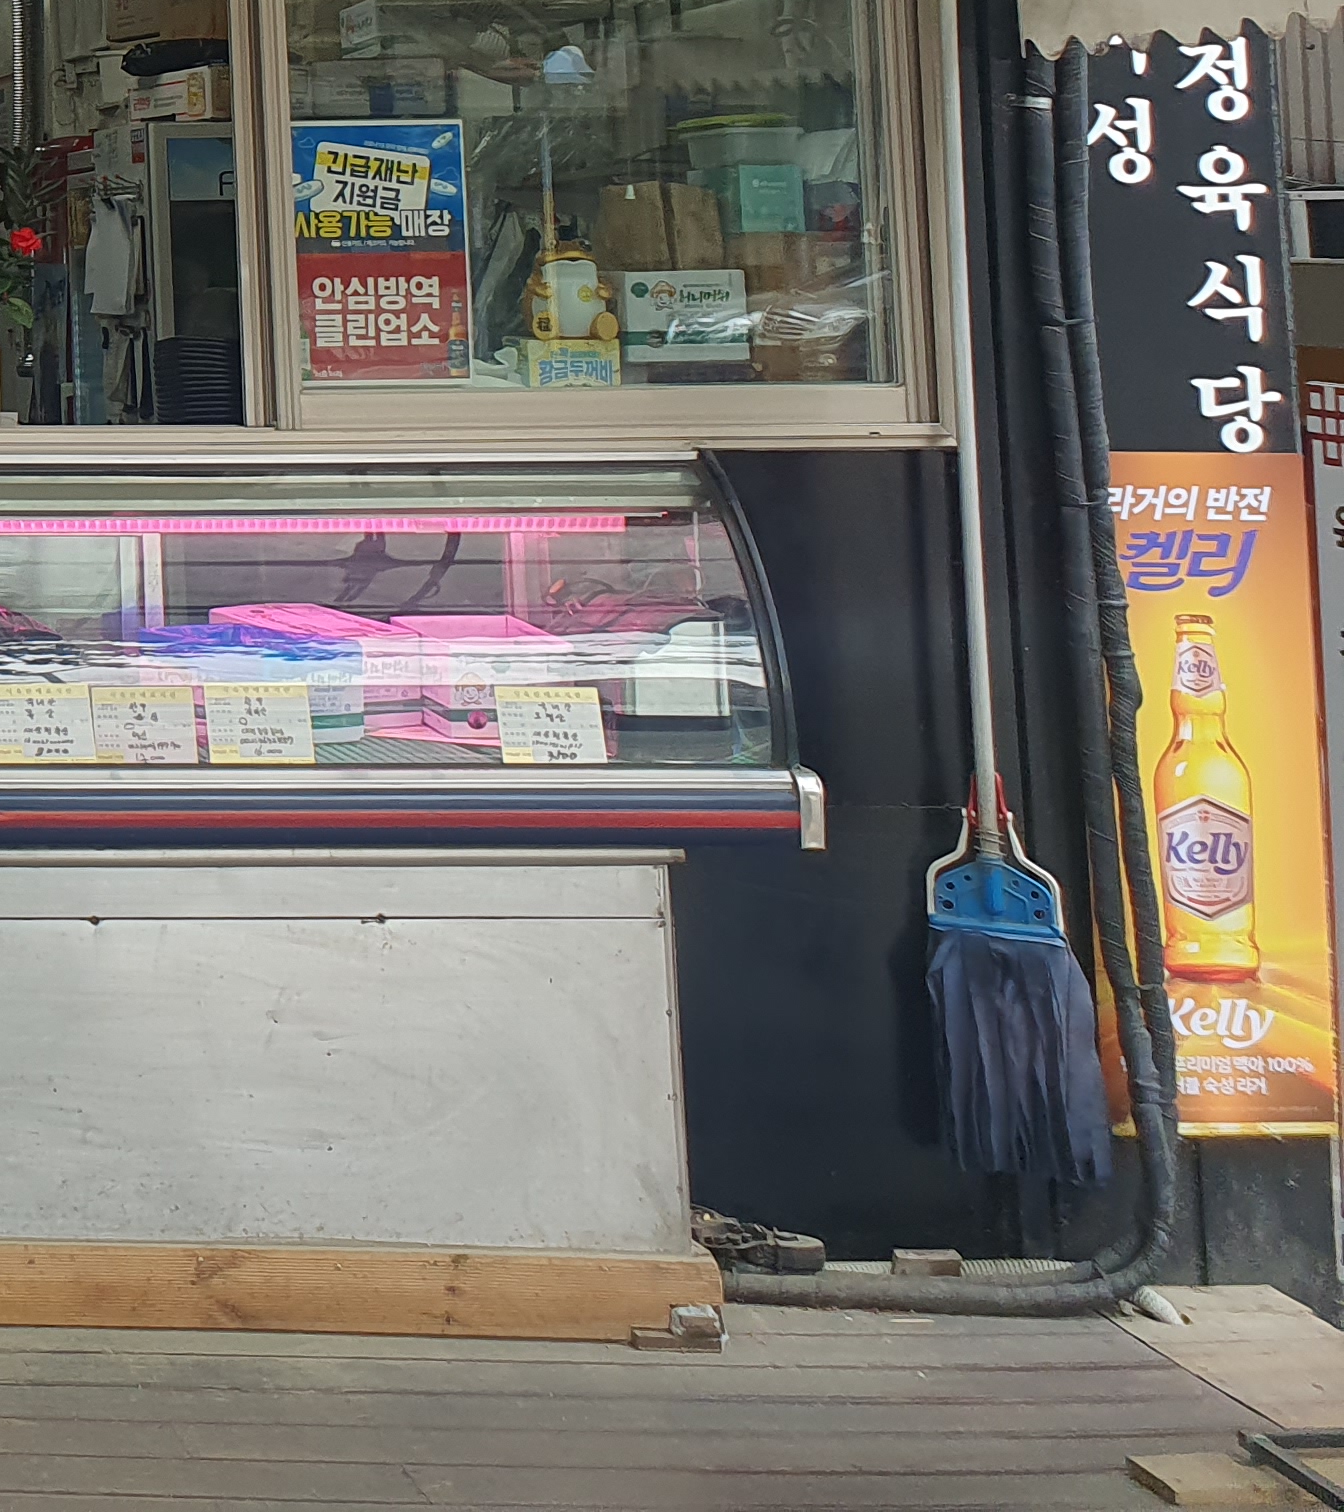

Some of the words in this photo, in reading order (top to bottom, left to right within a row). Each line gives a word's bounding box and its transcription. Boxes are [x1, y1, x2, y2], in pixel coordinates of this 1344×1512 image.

[326, 150, 418, 185] 긴급재난
[332, 179, 401, 211] 지원금
[295, 210, 392, 238] 사용가능
[400, 209, 452, 237] 매장
[1175, 37, 1282, 454] 정육식당
[312, 275, 440, 310] 안심방역
[315, 313, 440, 347] 클린업소
[538, 359, 612, 386] 황금두꺼비
[1107, 485, 1199, 521] 라거의
[1206, 486, 1272, 521] 반전
[1119, 529, 1260, 597] 켈리
[1178, 658, 1215, 677] Kelly
[1165, 831, 1249, 875] Kelly
[1168, 997, 1275, 1049] Kelly
[1268, 1055, 1316, 1074] 100%
